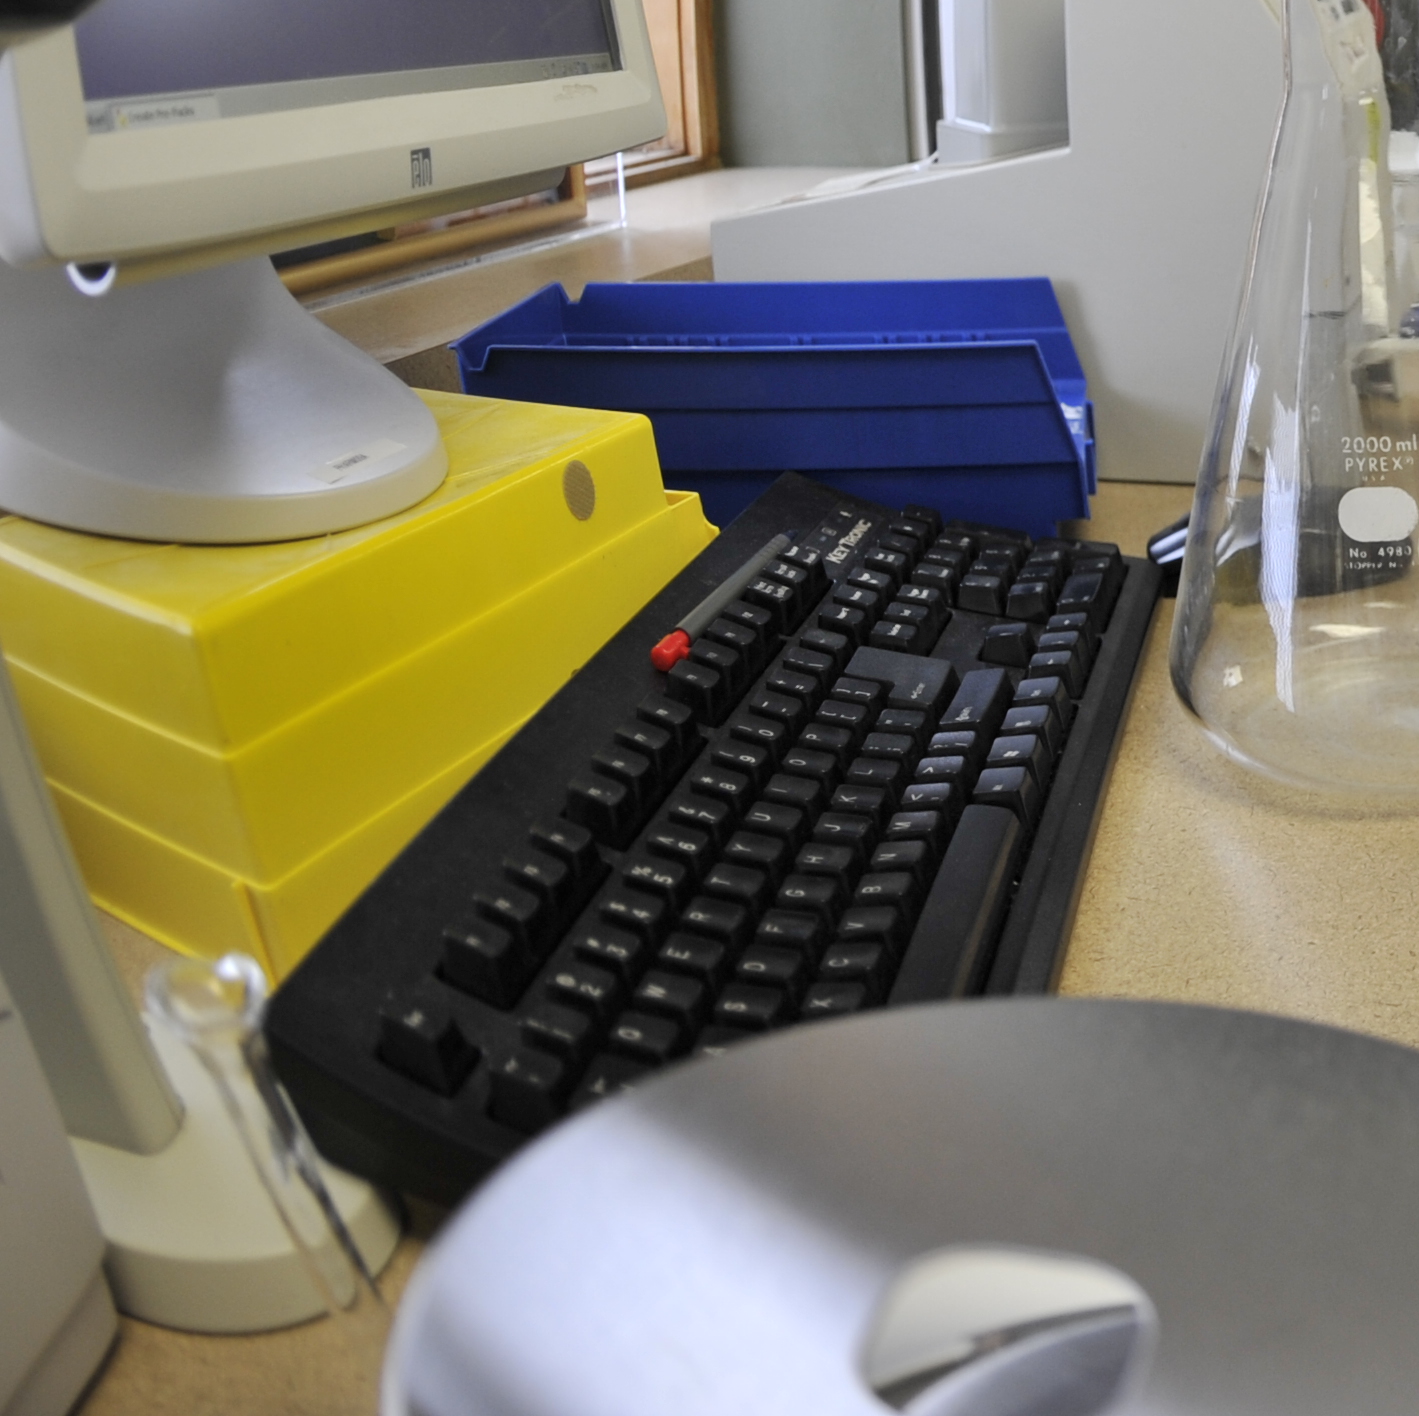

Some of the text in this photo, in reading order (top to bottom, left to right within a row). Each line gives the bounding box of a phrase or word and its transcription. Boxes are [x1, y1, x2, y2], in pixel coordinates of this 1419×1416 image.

[1341, 434, 1418, 453] 2000 ml
[1345, 456, 1404, 472] PYREX
[1378, 546, 1412, 557] 4980
